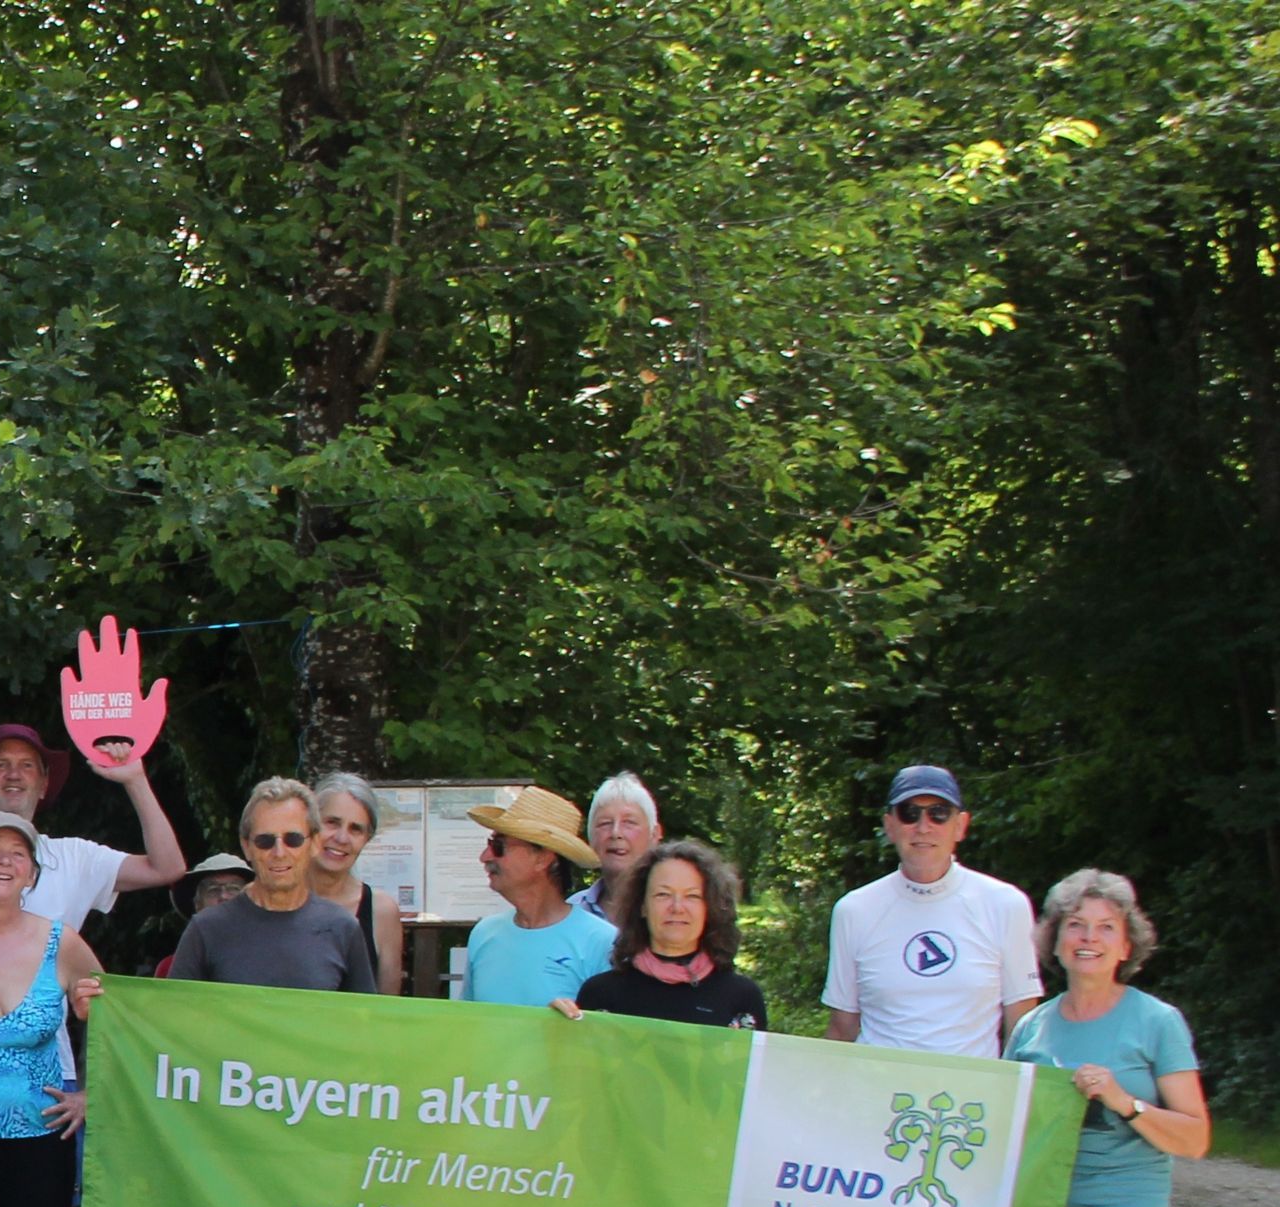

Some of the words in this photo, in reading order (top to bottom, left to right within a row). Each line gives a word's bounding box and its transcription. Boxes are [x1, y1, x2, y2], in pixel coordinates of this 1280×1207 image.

[69, 691, 106, 708] HÄNDE
[108, 693, 132, 707] WEG
[70, 709, 86, 720] VON
[87, 708, 104, 719] DER
[155, 1053, 201, 1104] In
[218, 1060, 401, 1126] Bayern
[417, 1076, 552, 1131] aktiv
[360, 1146, 421, 1190] für
[427, 1152, 576, 1200] Mensch
[775, 1161, 885, 1200] BUND
